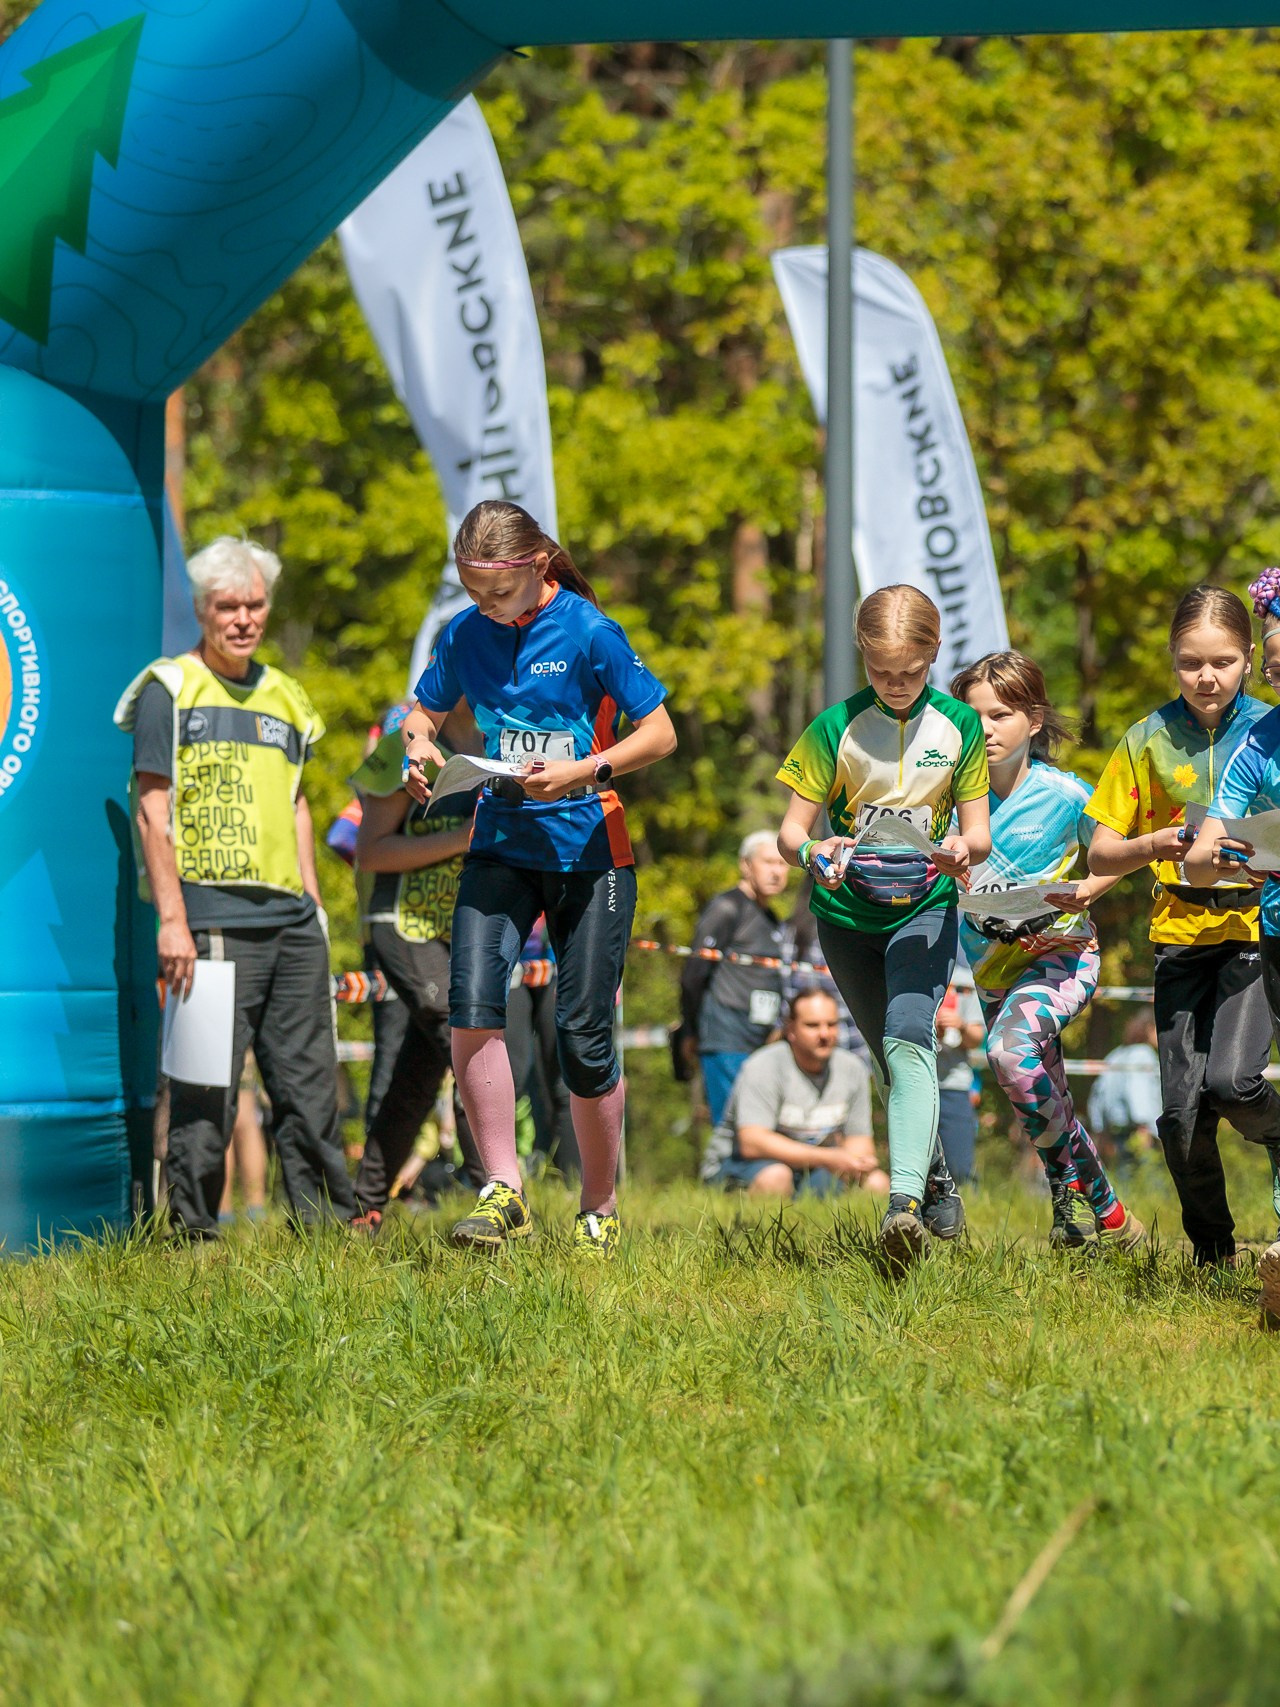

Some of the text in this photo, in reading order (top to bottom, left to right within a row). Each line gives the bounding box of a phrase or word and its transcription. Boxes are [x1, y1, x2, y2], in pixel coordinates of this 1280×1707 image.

[507, 729, 551, 754] 707
[563, 742, 571, 756] 1
[922, 817, 928, 832] 1
